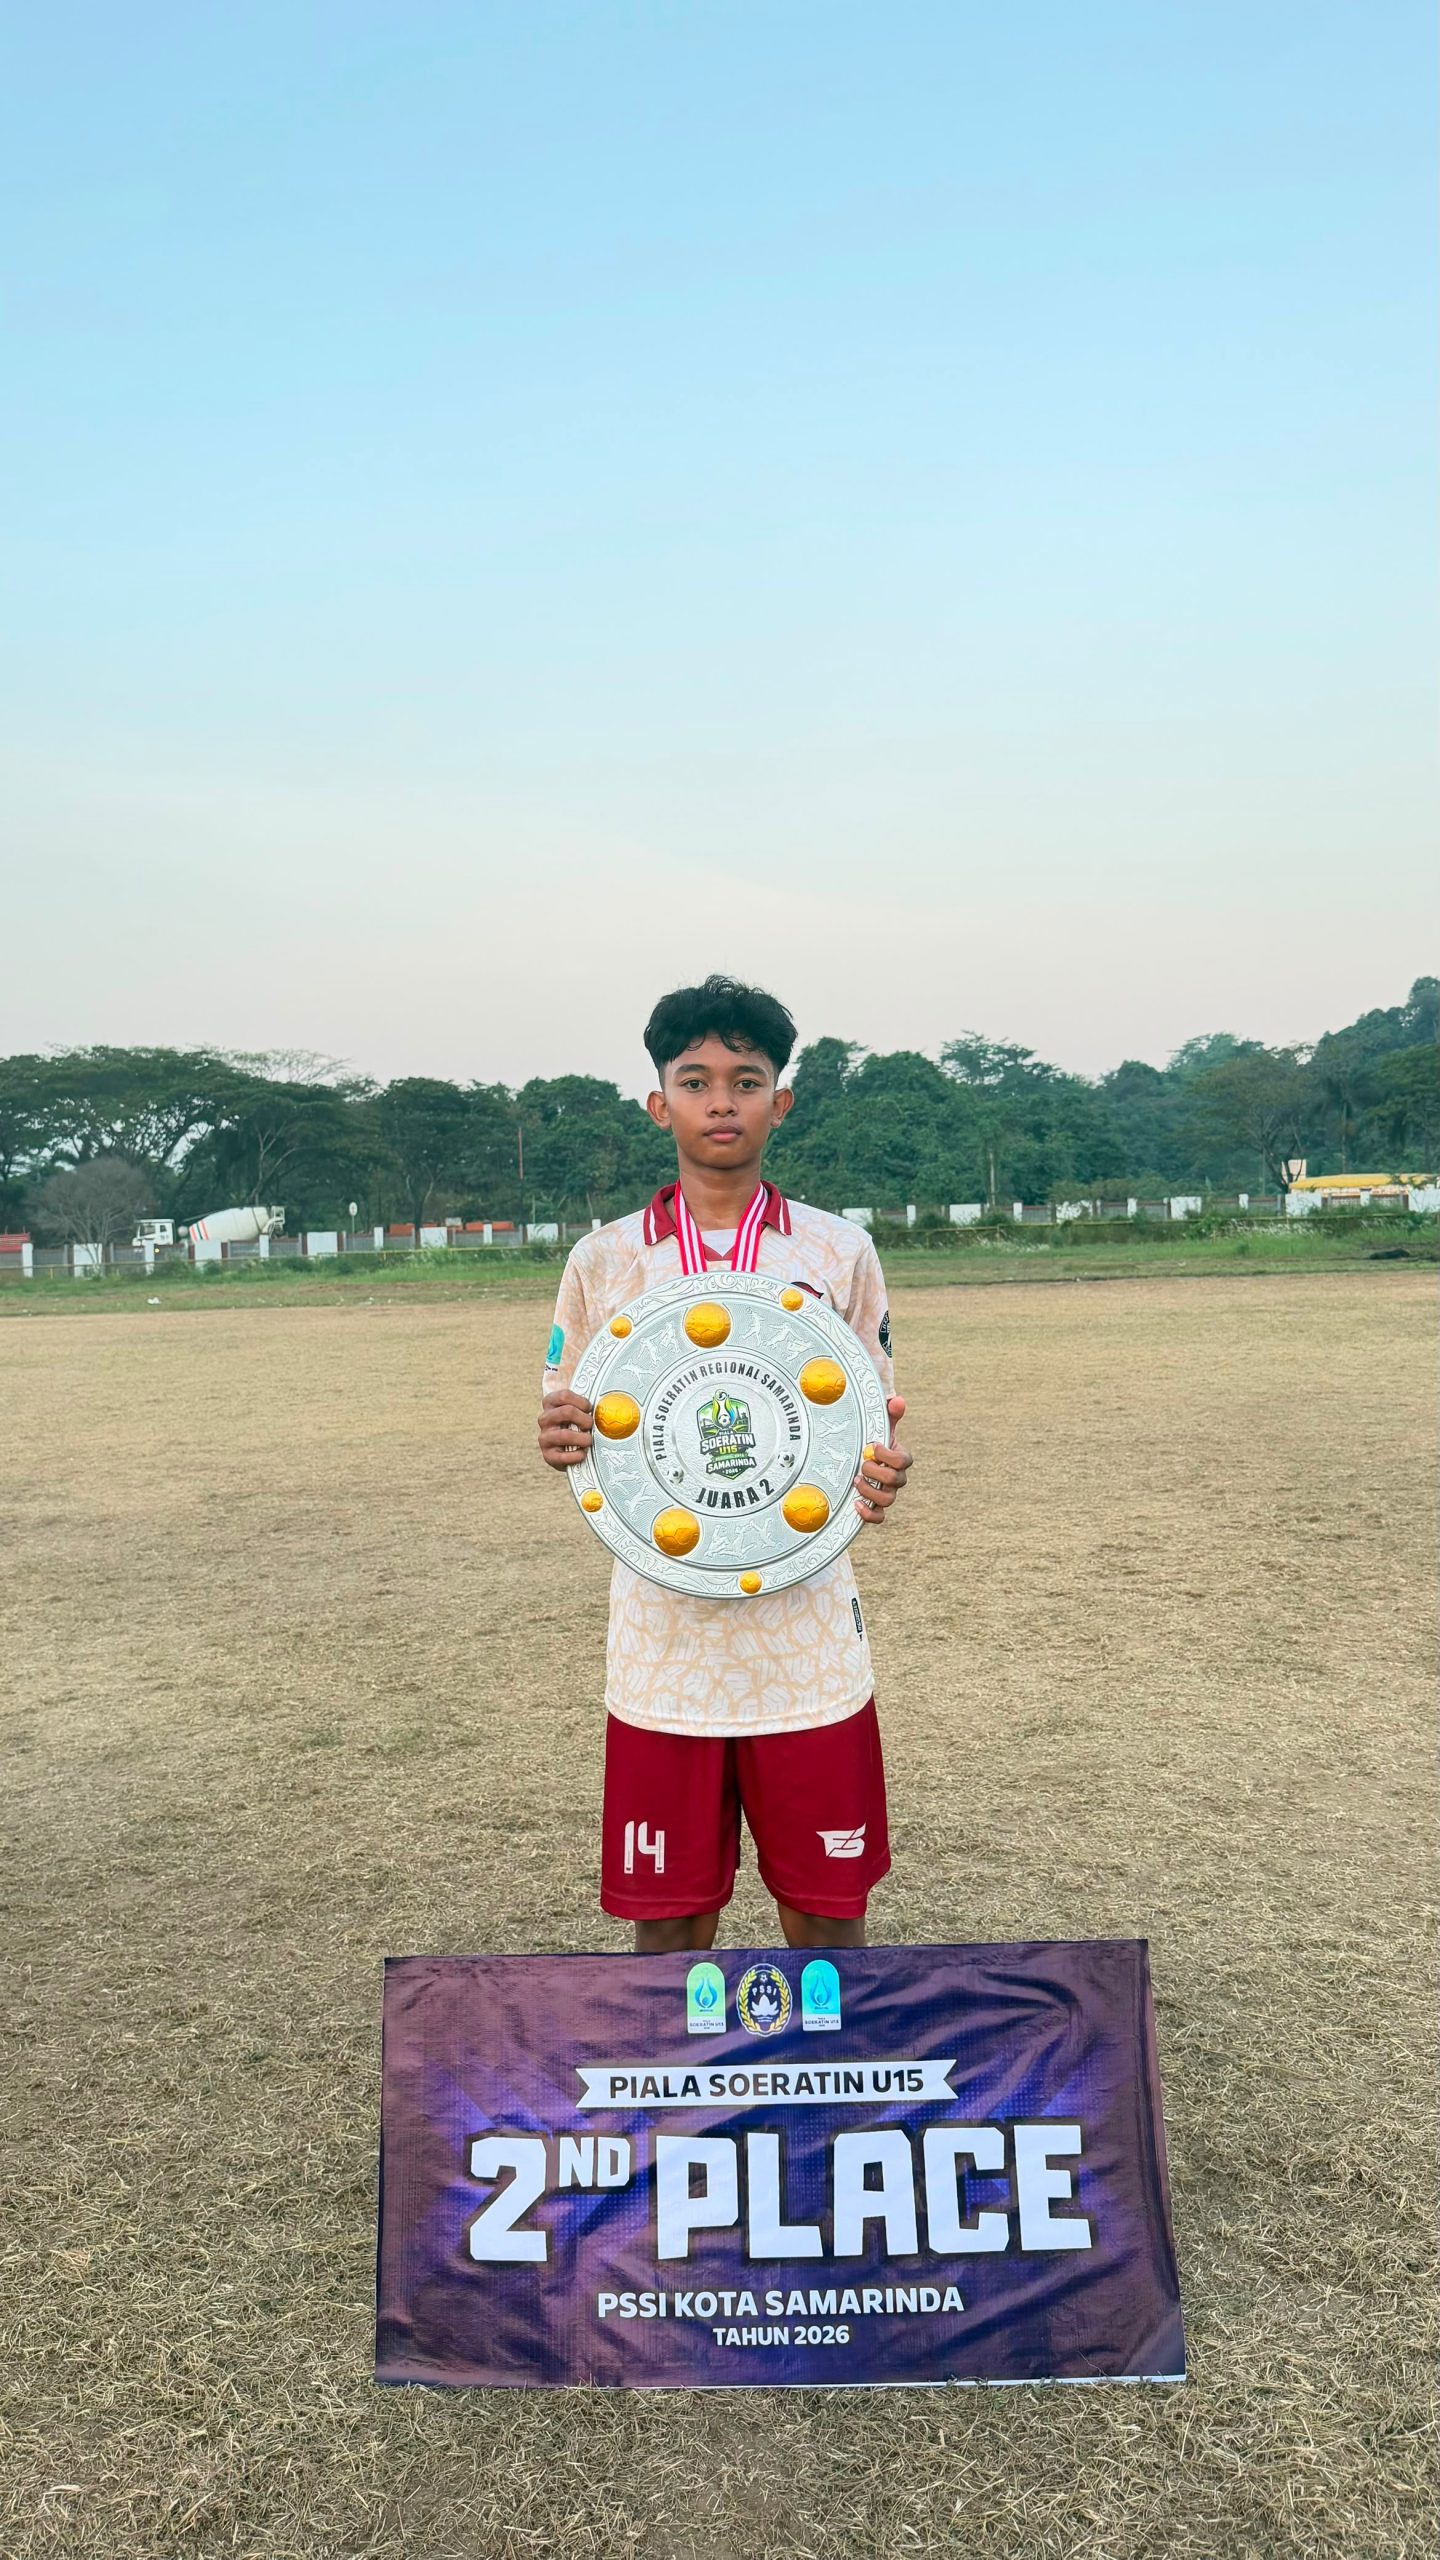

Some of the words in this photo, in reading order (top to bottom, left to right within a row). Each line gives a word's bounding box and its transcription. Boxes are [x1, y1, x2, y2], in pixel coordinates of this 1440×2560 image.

[699, 1361, 759, 1380] REGIONAL
[658, 1370, 699, 1422] SOERATIN
[761, 1373, 801, 1441] SAMARINDA
[653, 1425, 667, 1461] PIALA
[701, 1433, 754, 1454] SOERATIN
[720, 1445, 738, 1454] U15
[707, 1458, 755, 1473] SAMARINDA
[695, 1487, 761, 1509] JUARA
[759, 1478, 775, 1496] 2
[624, 1820, 665, 1874] 14
[751, 1985, 777, 1997] PSSI
[610, 2074, 701, 2099] PIALA
[709, 2070, 864, 2098] SOERATIN
[872, 2069, 924, 2093] U15
[470, 2136, 631, 2262] 2ND
[654, 2125, 1092, 2260] PLACE
[598, 2292, 667, 2318] PSSI
[674, 2291, 758, 2318] KOTA
[765, 2287, 965, 2316] SAMARINDA
[713, 2327, 790, 2346] TAHUN
[794, 2325, 850, 2345] 2026
